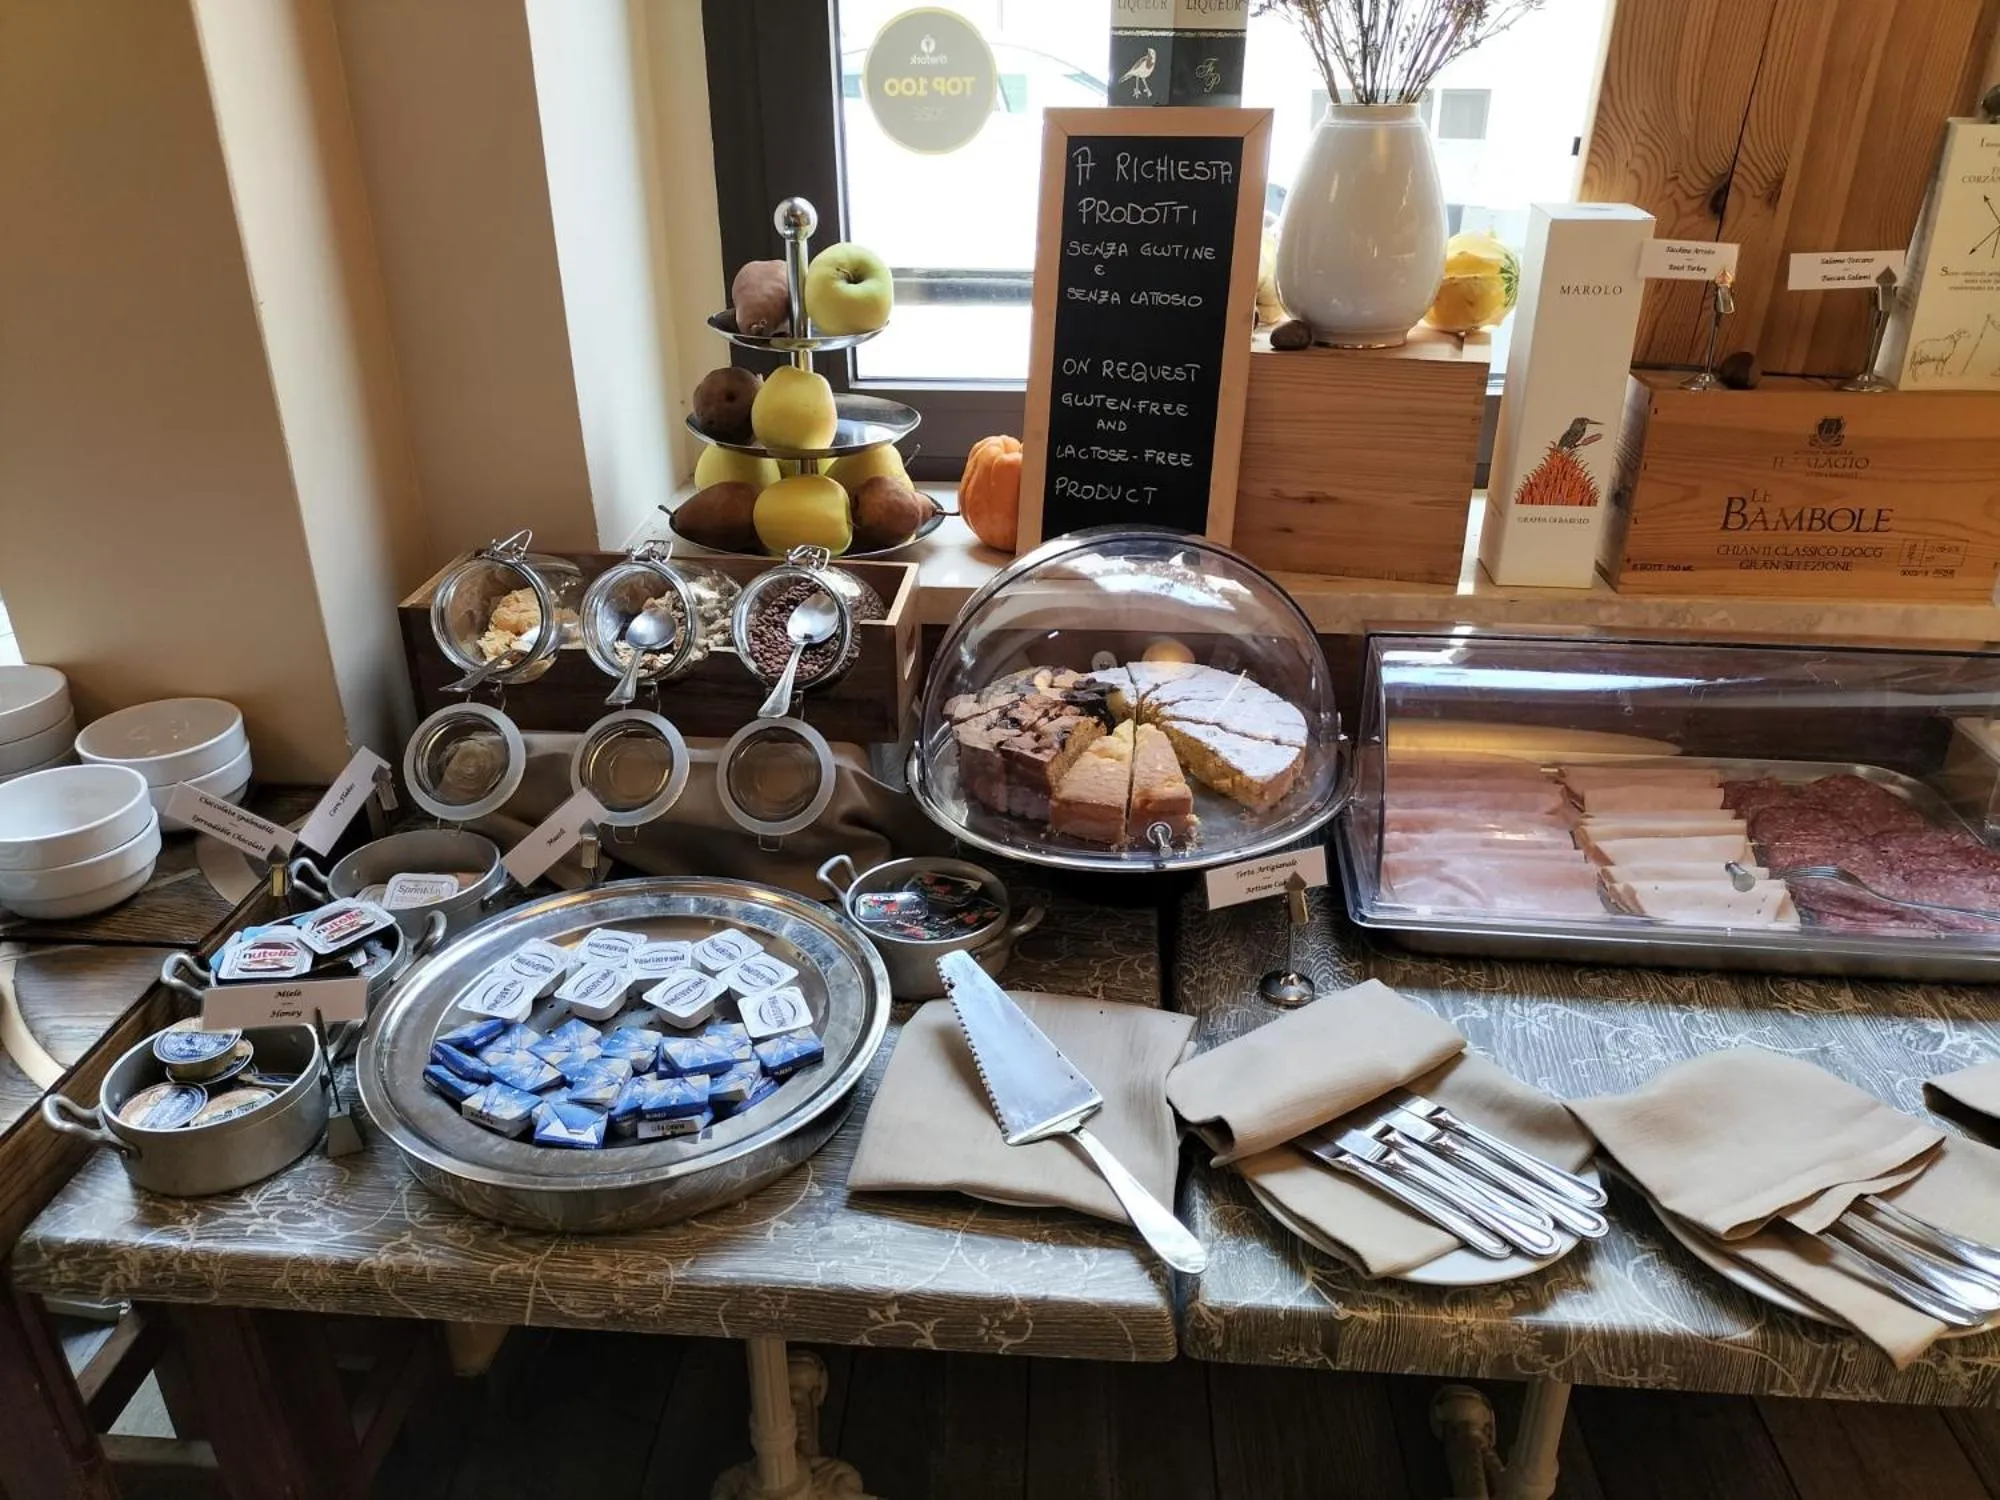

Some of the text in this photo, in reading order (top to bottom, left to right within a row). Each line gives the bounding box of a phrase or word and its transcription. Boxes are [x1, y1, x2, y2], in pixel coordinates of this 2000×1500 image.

[1072, 146, 1234, 187] A RICHIESTA
[1078, 196, 1197, 227] PRODOTTI
[1066, 240, 1129, 257] SENZA
[1066, 287, 1203, 307] SENZA LATTOSIO
[1559, 284, 1624, 297] MAROLO
[1062, 357, 1202, 383] ON REQUEST
[1061, 392, 1190, 418] GLUTEN-FREE
[1096, 418, 1128, 433] AND
[1055, 476, 1158, 505] PRODUCT
[1719, 496, 1895, 533] BAMBOLE
[1775, 545, 1838, 557] CLASSICO
[1841, 546, 1885, 559] DOCG
[316, 908, 364, 935] nutella
[243, 949, 299, 960] nutella
